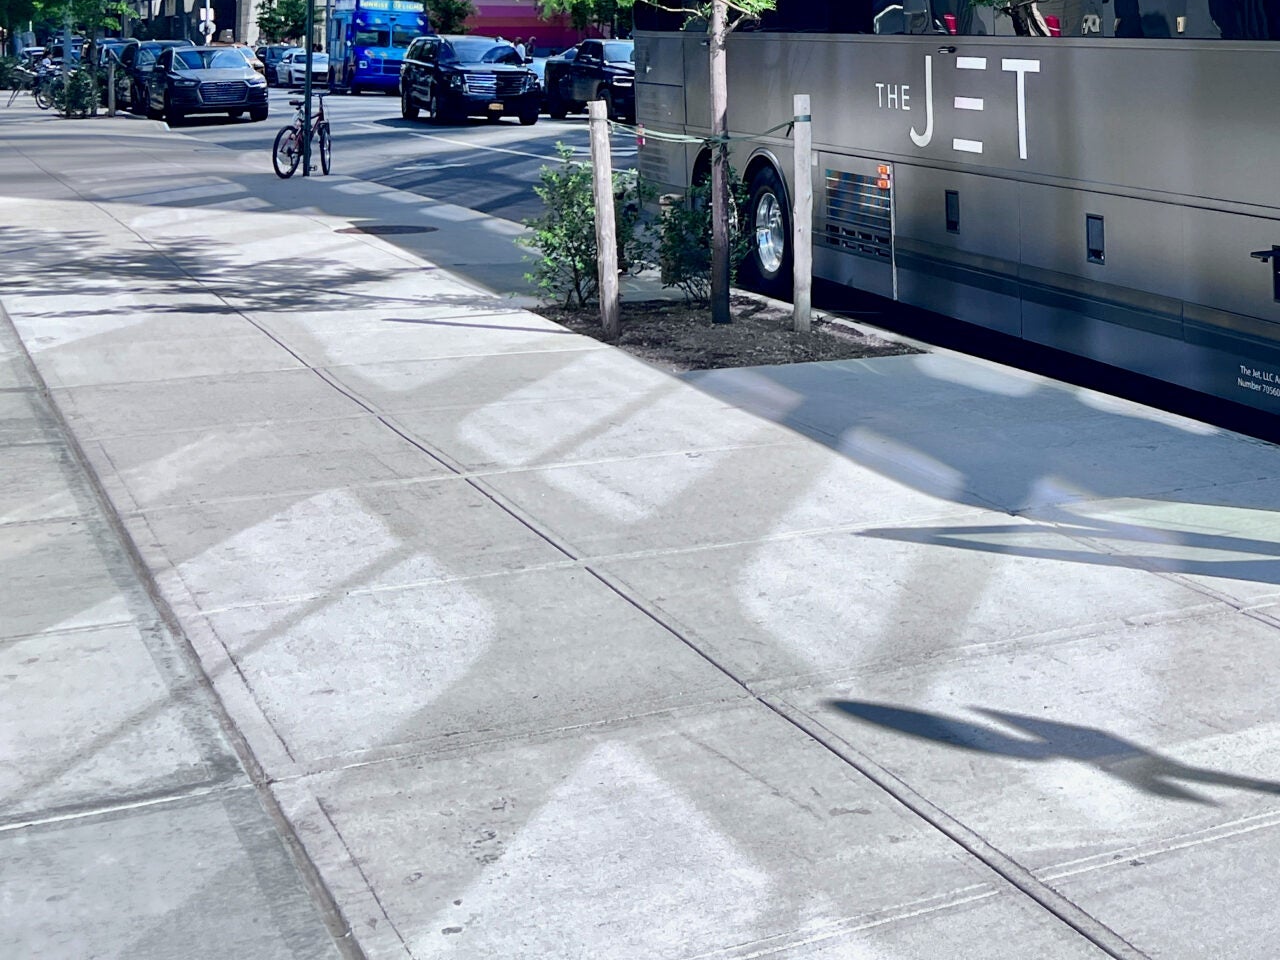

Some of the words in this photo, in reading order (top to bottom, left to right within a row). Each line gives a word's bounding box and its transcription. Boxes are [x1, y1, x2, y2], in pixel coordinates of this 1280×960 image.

[875, 83, 911, 111] THE
[910, 55, 1041, 160] JET
[1240, 365, 1251, 376] The
[1263, 372, 1274, 382] LLC
[1238, 377, 1261, 391] Number
